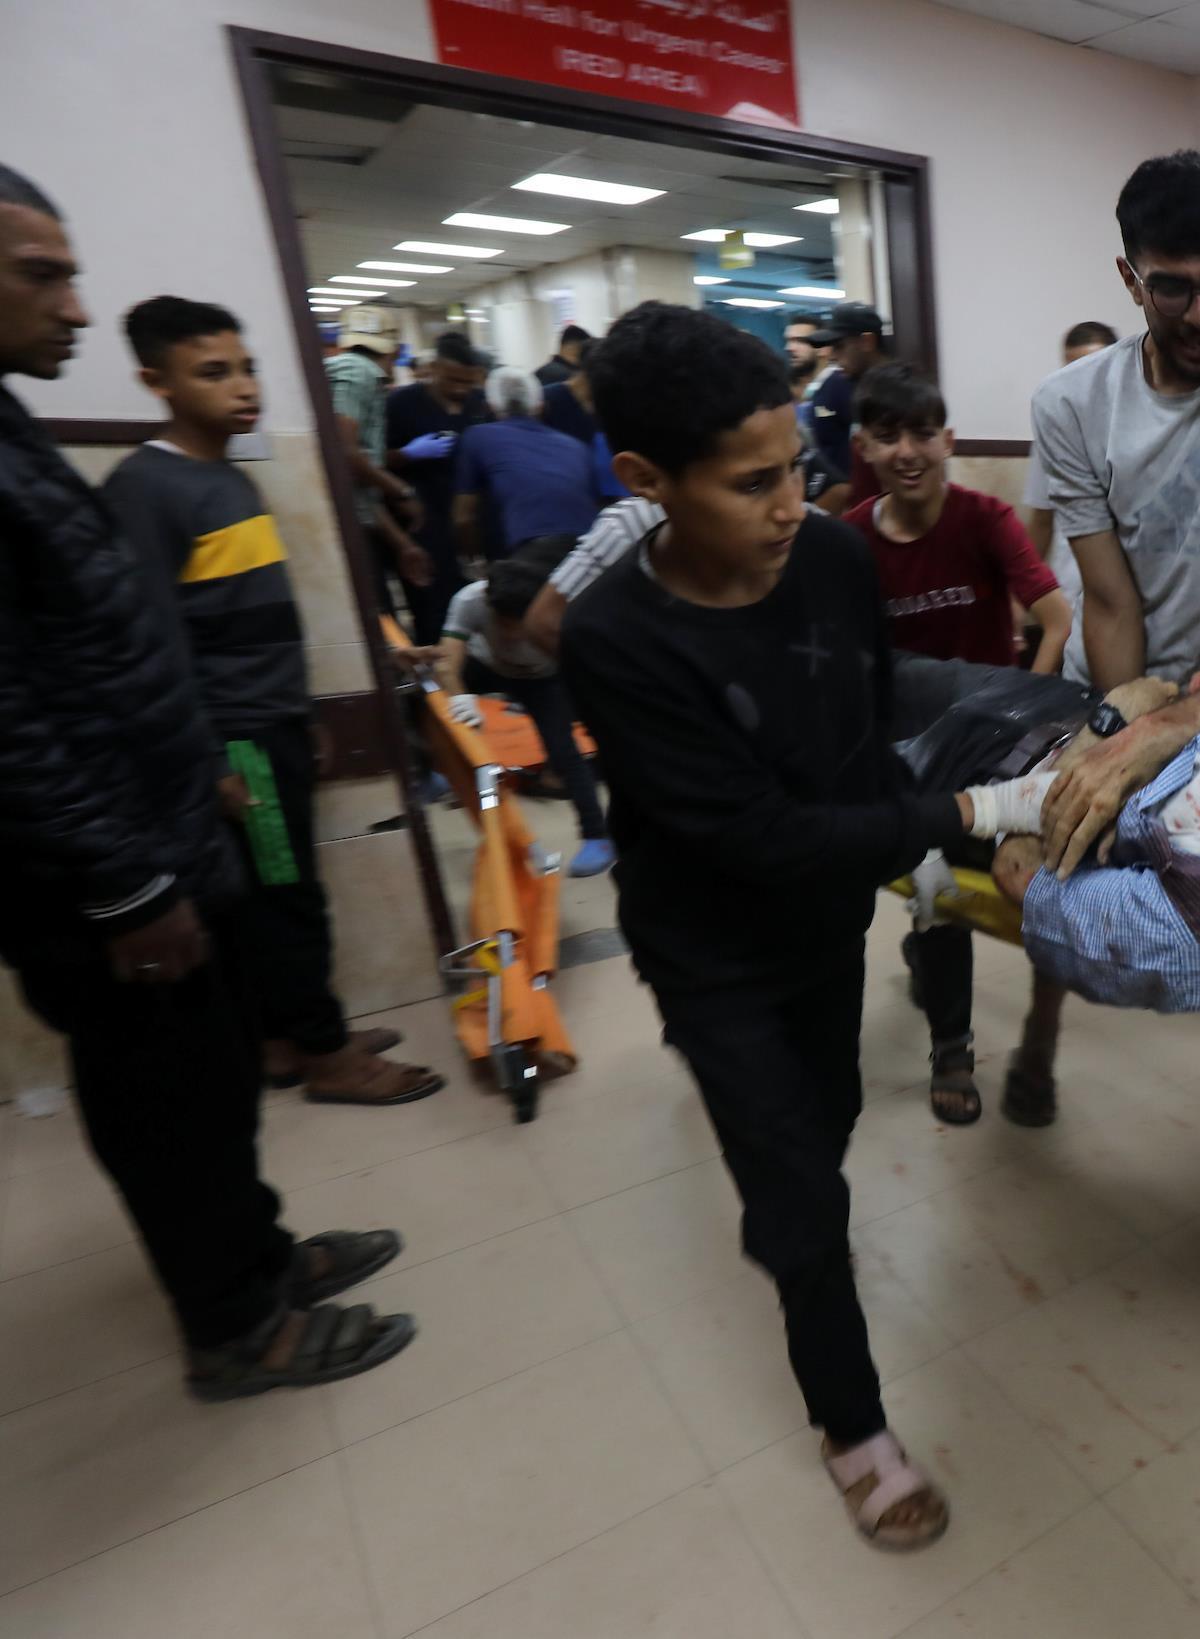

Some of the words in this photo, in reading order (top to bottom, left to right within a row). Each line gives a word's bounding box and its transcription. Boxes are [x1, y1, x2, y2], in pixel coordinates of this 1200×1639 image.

[522, 4, 577, 28] Hall
[579, 10, 620, 37] for
[622, 20, 708, 57] Urgent
[709, 41, 785, 74] Cases
